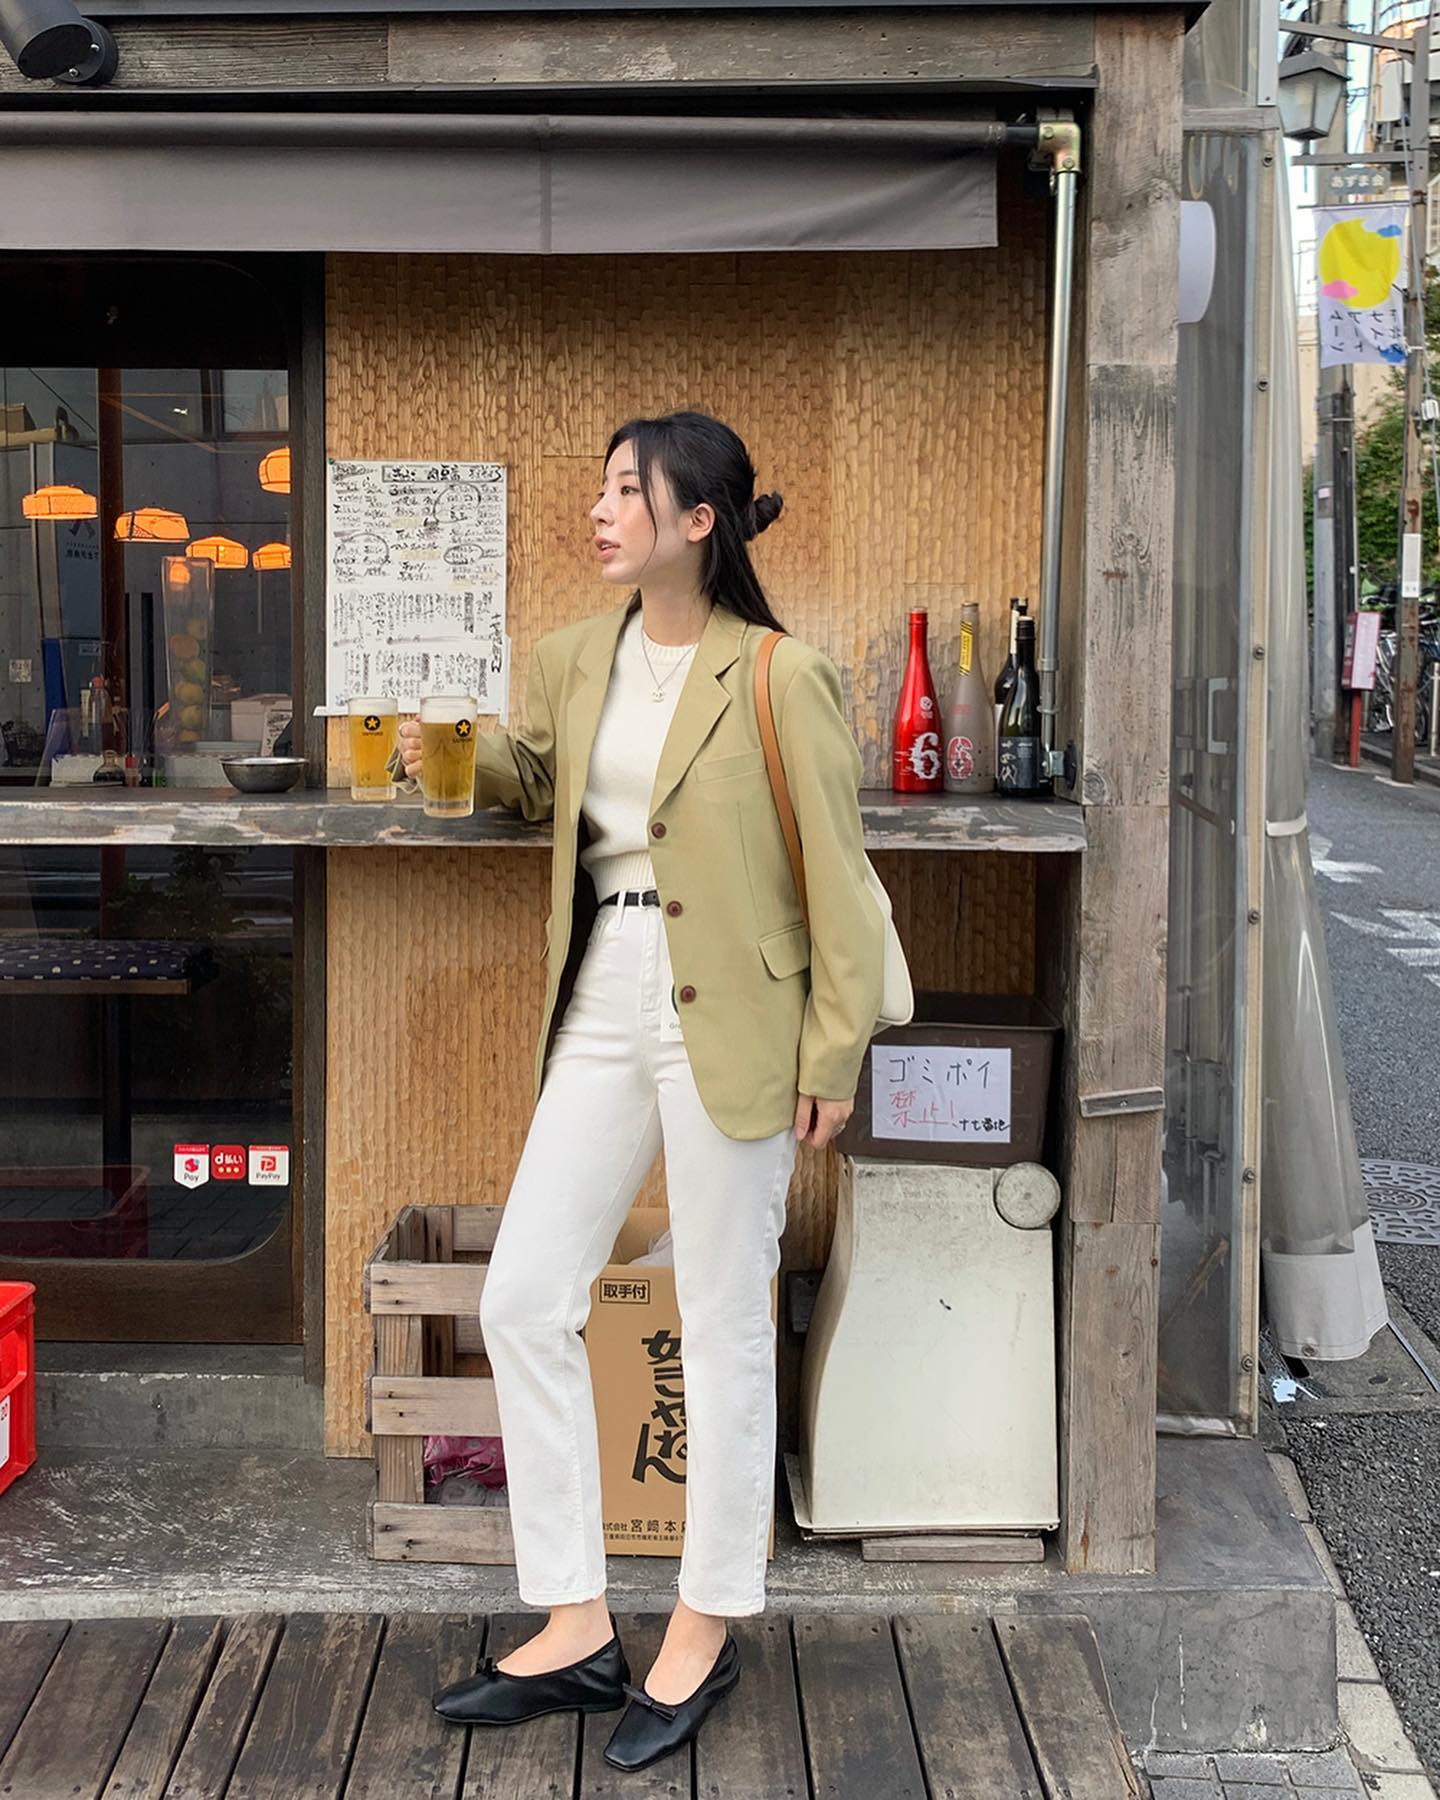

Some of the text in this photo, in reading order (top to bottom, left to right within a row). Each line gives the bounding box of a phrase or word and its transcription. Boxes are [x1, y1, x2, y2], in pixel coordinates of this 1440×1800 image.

[911, 731, 941, 780] 6
[946, 735, 974, 780] 6
[888, 1055, 991, 1089] ゴミポイ
[255, 1172, 281, 1181] PayPay
[603, 1283, 647, 1299] 取手付
